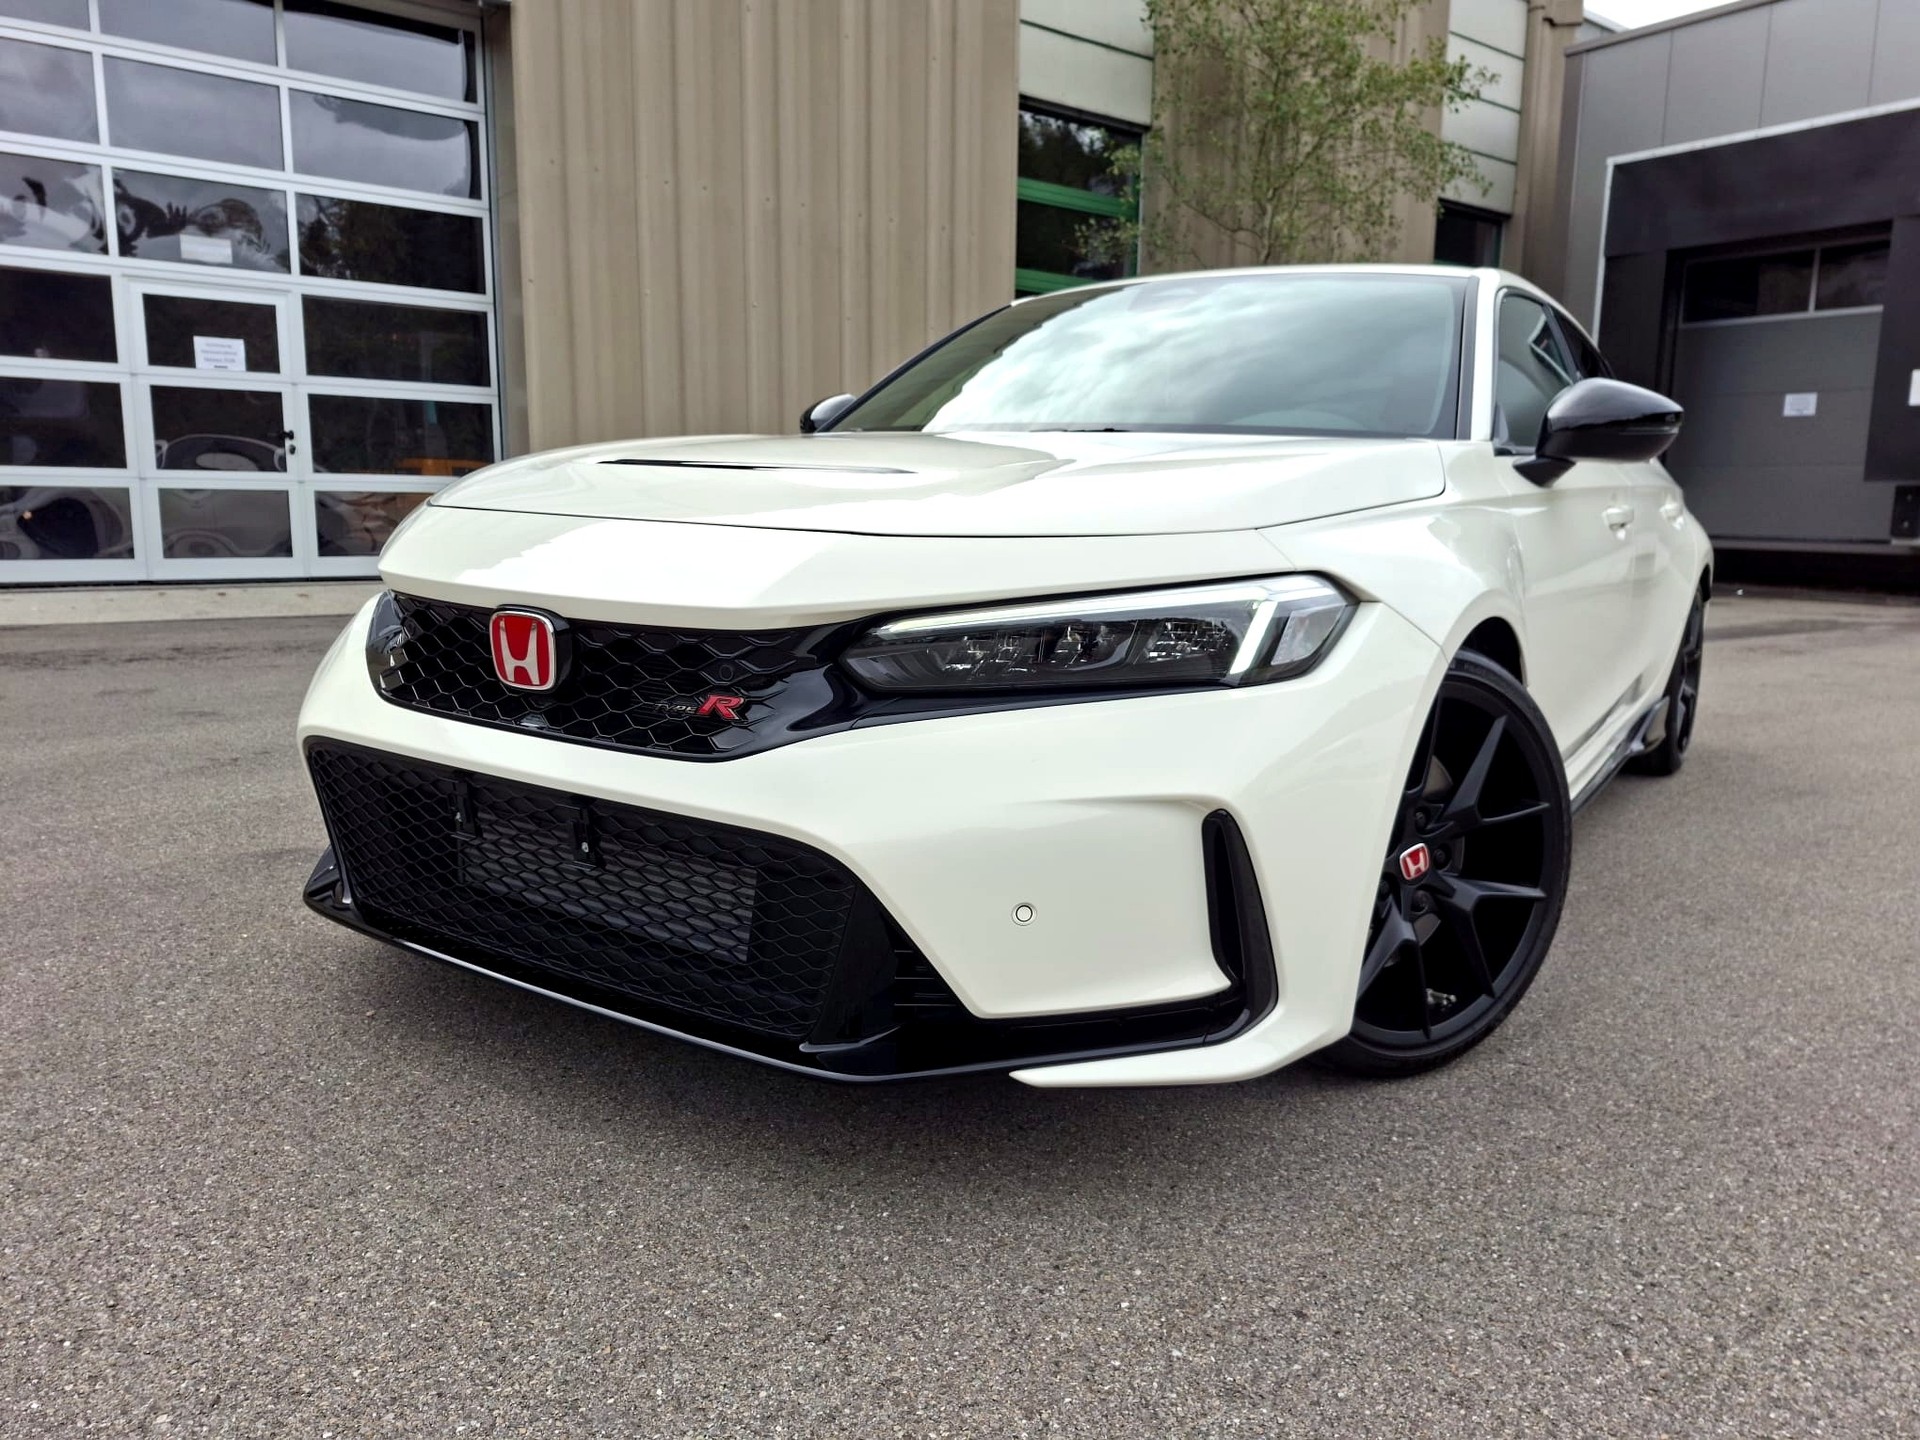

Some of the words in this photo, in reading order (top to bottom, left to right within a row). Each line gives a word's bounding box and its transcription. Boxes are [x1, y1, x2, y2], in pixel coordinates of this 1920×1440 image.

[500, 617, 540, 685] H
[655, 703, 697, 714] TYPE
[697, 694, 744, 719] R
[1404, 849, 1425, 879] H
